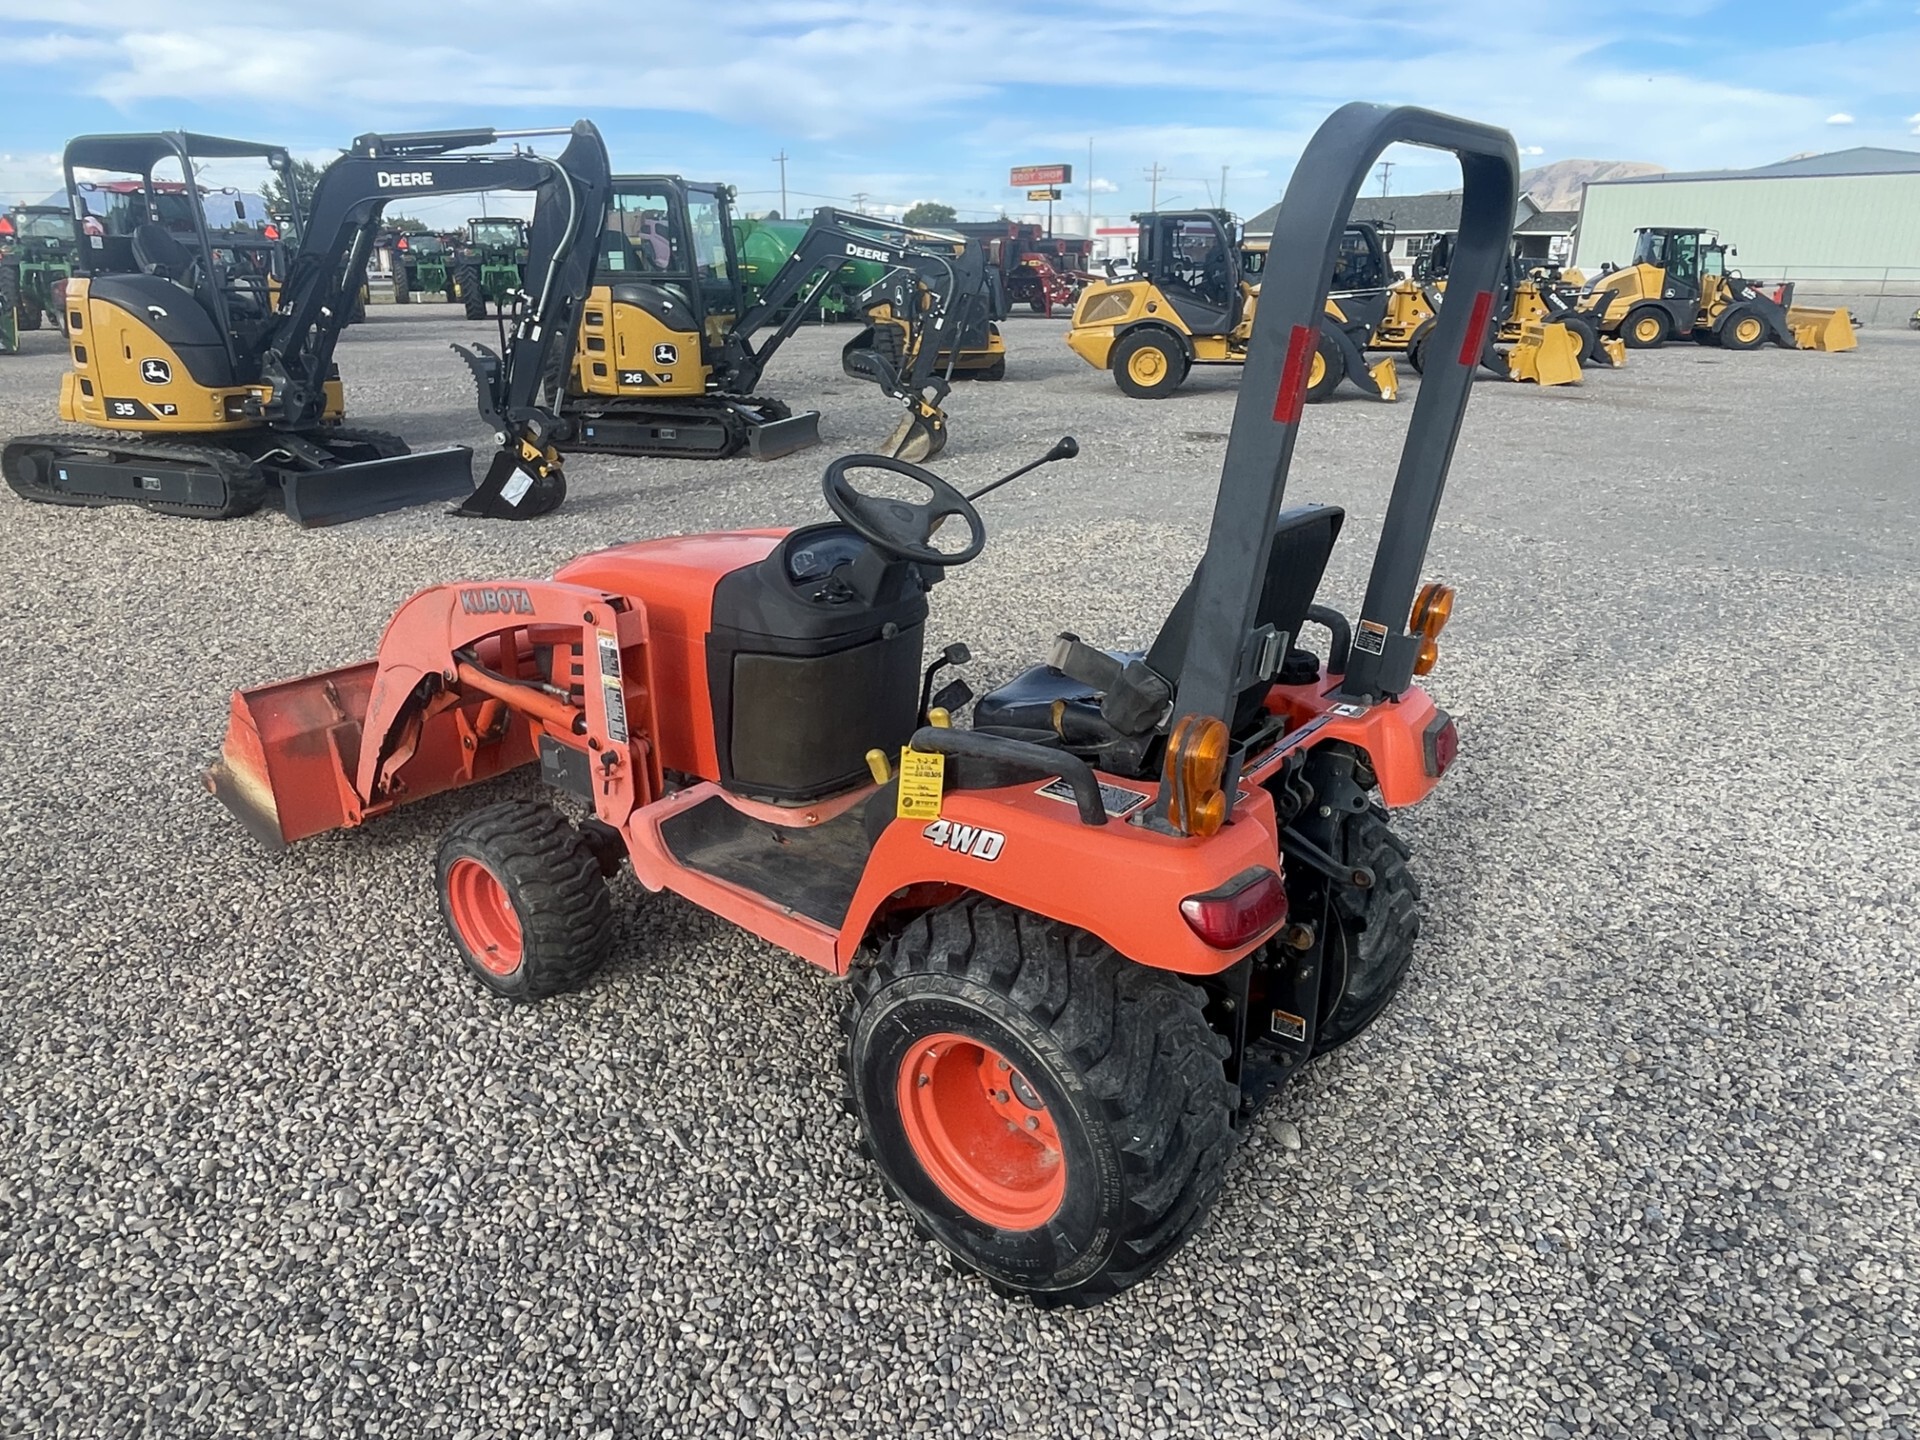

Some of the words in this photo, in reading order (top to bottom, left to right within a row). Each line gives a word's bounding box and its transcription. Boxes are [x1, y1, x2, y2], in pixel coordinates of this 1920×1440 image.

[377, 171, 434, 188] DEERE
[1038, 169, 1062, 181] SHOP
[846, 243, 890, 263] DEERE
[624, 373, 643, 384] 26
[663, 374, 671, 382] P
[114, 403, 135, 416] 35
[164, 405, 175, 414] P
[460, 587, 535, 615] KUBOTA
[923, 818, 1005, 861] 4WD
